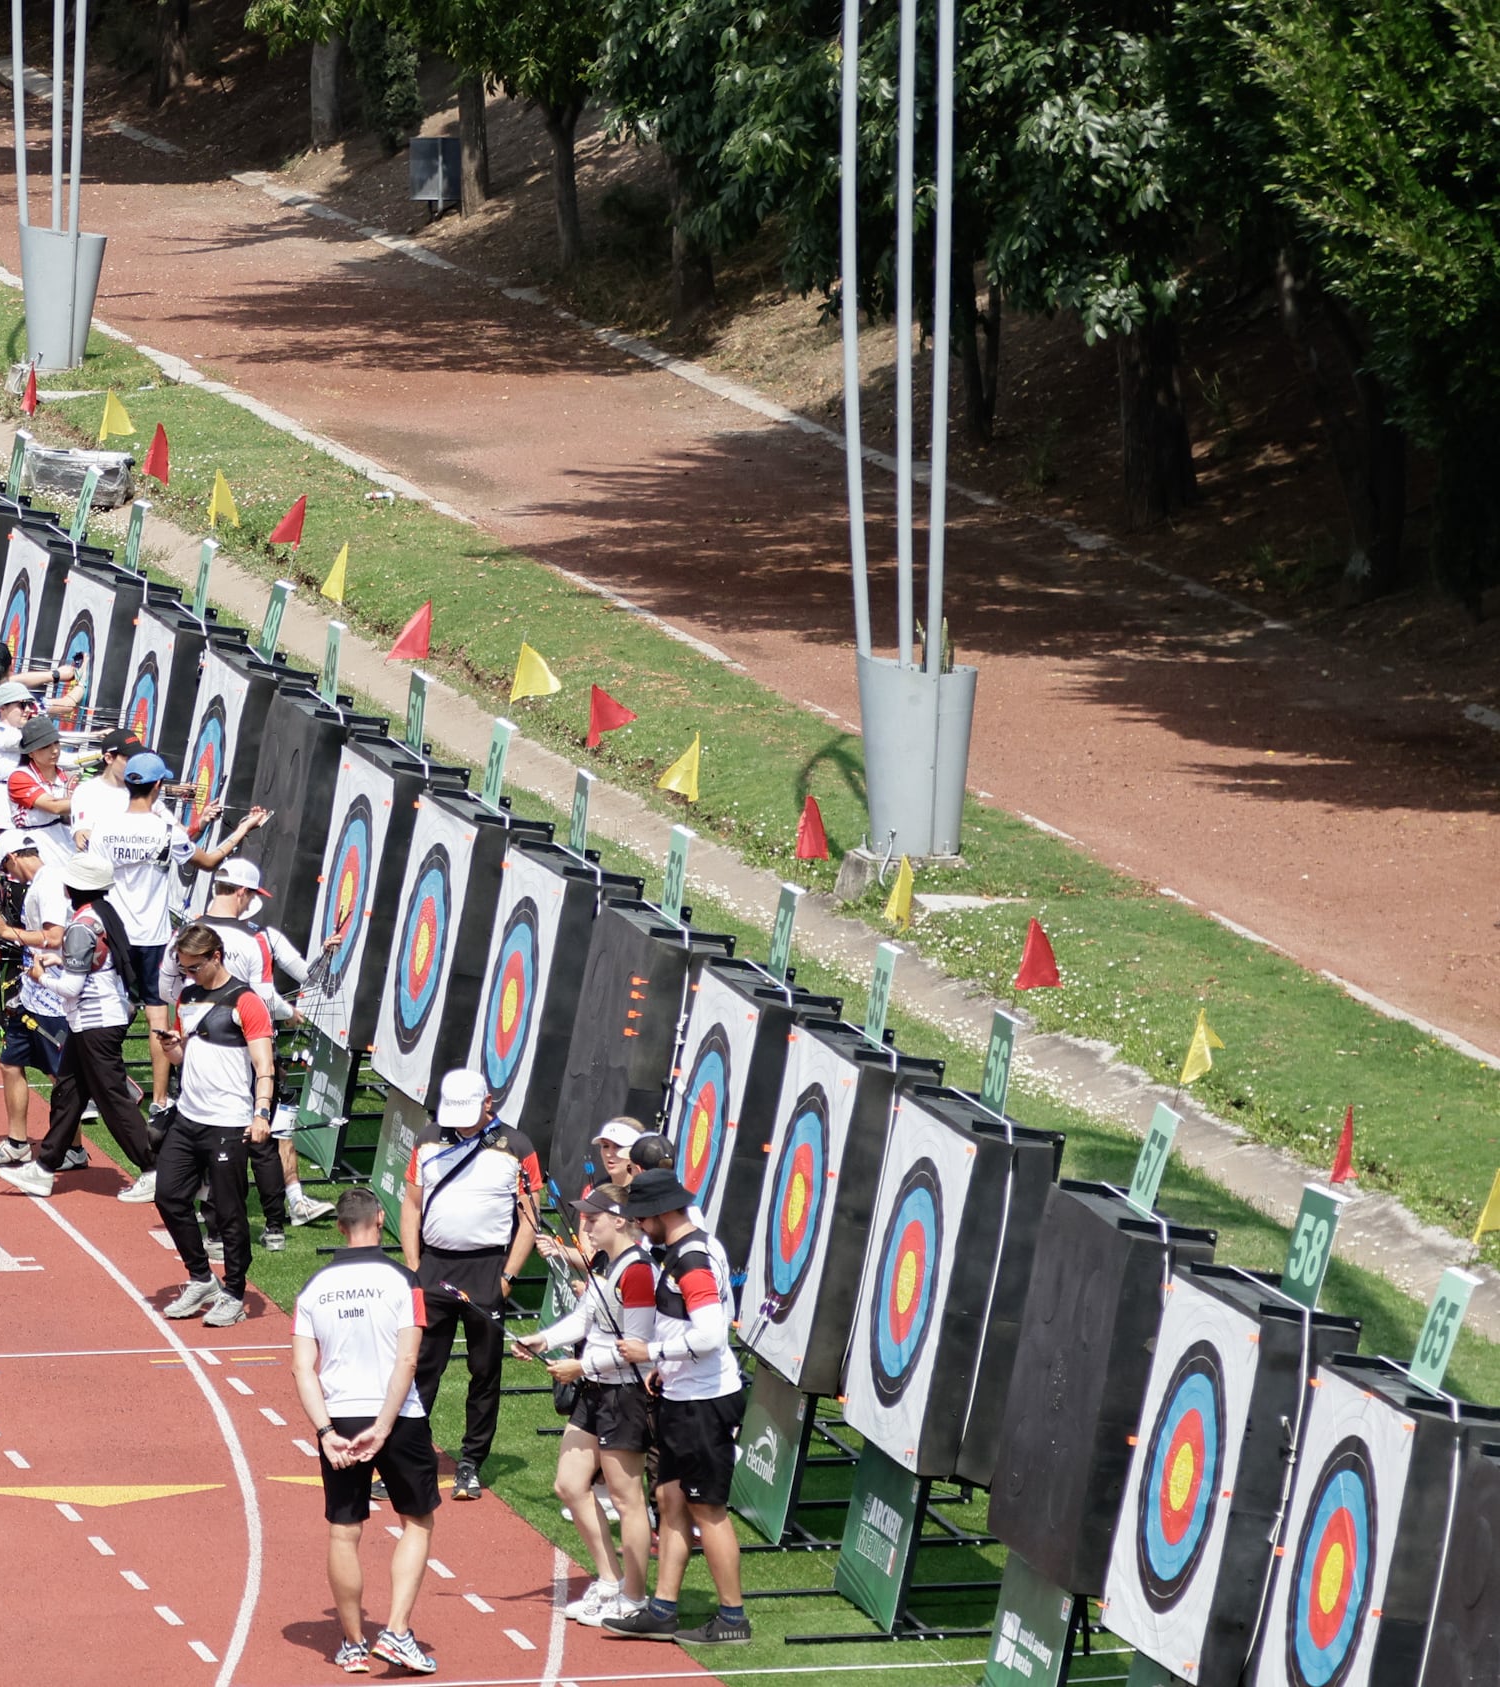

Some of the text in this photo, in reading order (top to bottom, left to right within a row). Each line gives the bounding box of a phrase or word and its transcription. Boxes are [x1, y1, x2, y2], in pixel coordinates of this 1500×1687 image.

[8, 448, 23, 495] 44
[75, 485, 91, 530] 45
[126, 519, 140, 567] 46
[195, 560, 208, 609] 47
[261, 600, 282, 650] 48
[323, 641, 337, 694] 49
[407, 691, 422, 747] 50
[485, 740, 504, 797] 51
[571, 792, 585, 851] 52
[665, 850, 683, 910] 53
[771, 907, 792, 969] 54
[868, 967, 889, 1030] 55
[984, 1035, 1008, 1103] 56
[1135, 1128, 1168, 1197] 57
[1288, 1212, 1329, 1287] 58
[319, 1288, 385, 1305] GERMANY
[338, 1307, 365, 1319] Laube
[1419, 1296, 1460, 1370] 65
[746, 1443, 776, 1486] Electrolit
[868, 1496, 904, 1545] ARCHERY
[1012, 1651, 1033, 1679] mexico
[1032, 1639, 1053, 1671] archery
